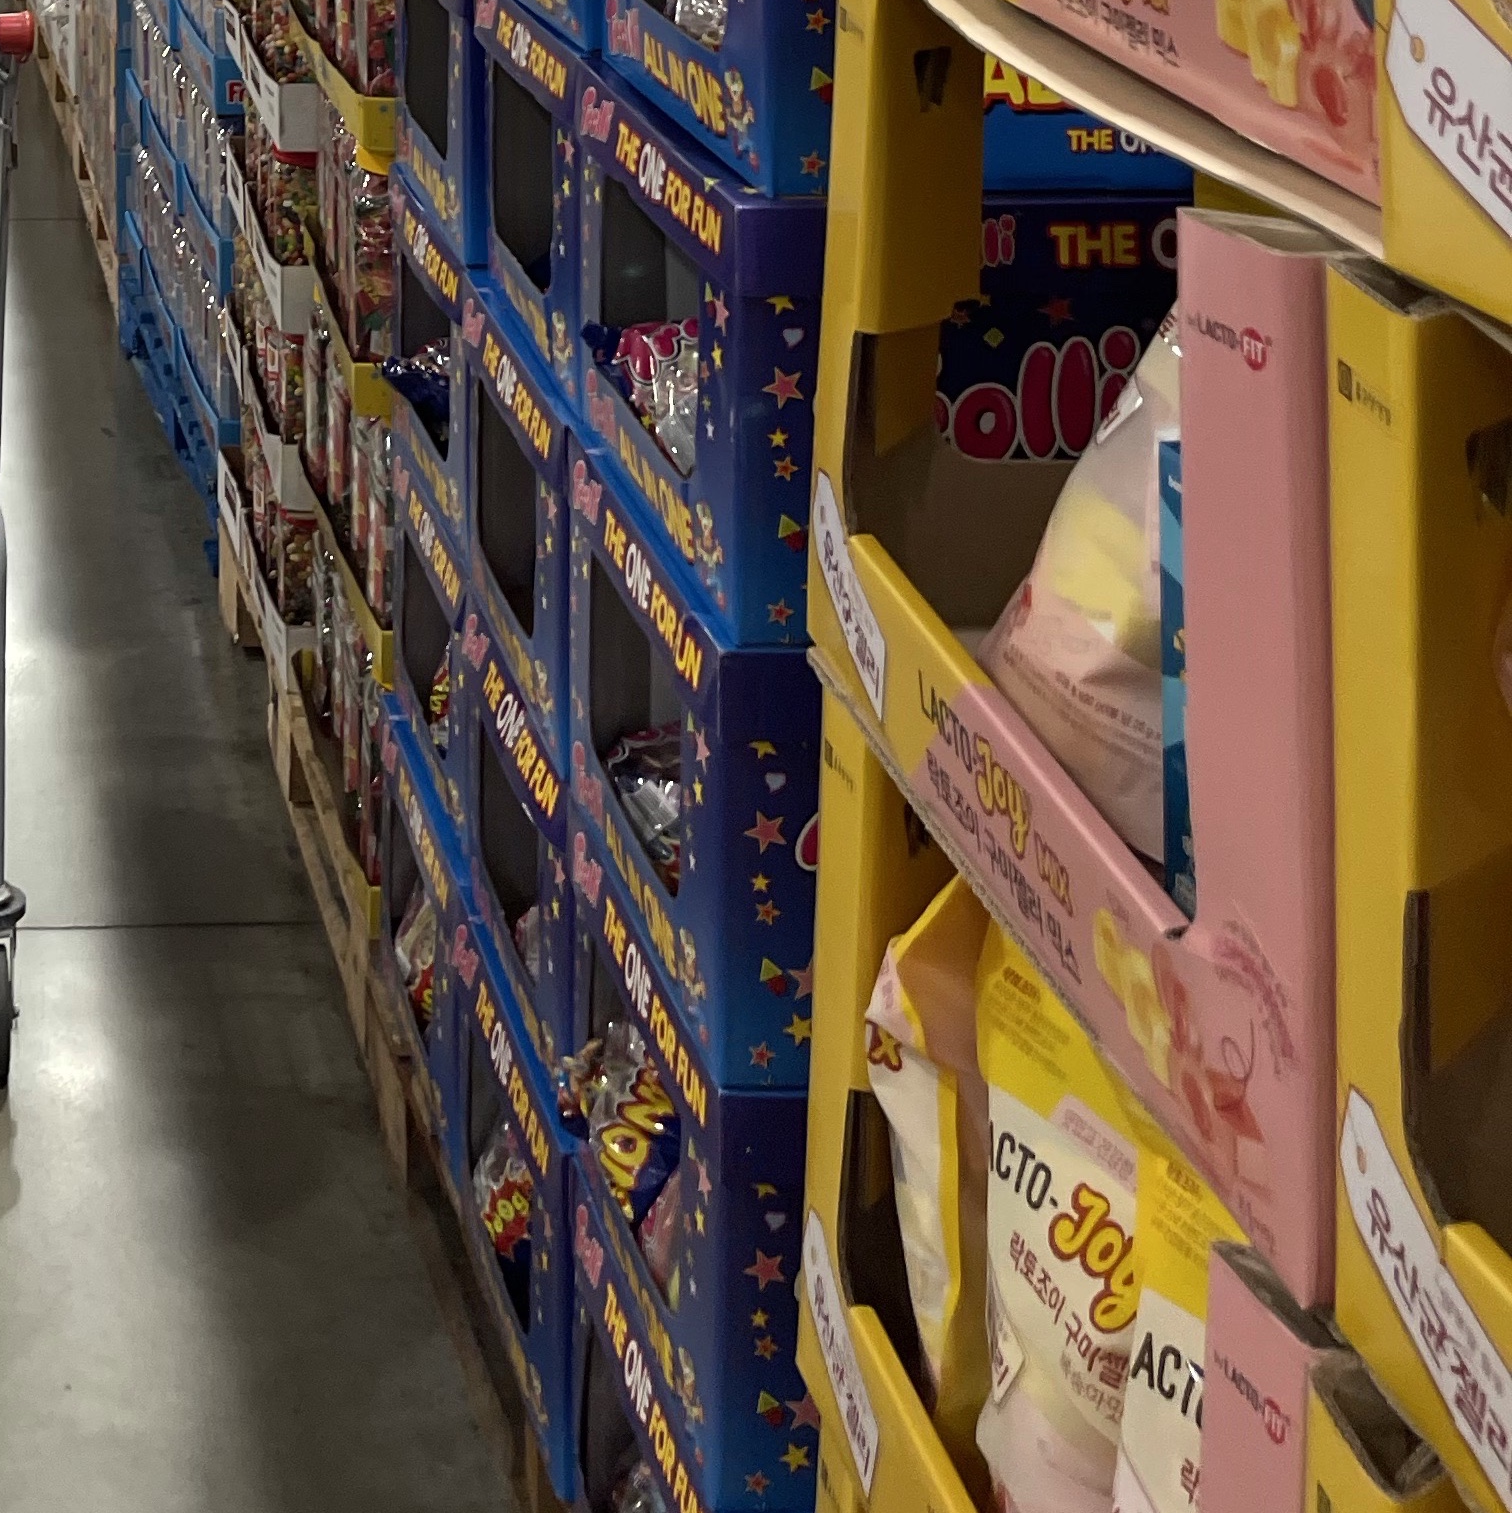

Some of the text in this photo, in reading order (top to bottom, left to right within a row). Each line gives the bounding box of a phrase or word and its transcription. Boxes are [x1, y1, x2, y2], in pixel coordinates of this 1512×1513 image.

[511, 22, 531, 68] ONE
[643, 31, 728, 136] ALL IN ONE
[615, 120, 723, 256] THE ONE FOR FUN
[1065, 128, 1115, 154] THE
[1048, 222, 1140, 270] THE
[496, 354, 518, 407] ONE
[936, 326, 1141, 464] olli
[603, 507, 627, 570] THE
[624, 542, 652, 610] ONE
[649, 582, 678, 650] FOR
[483, 658, 505, 713] THE
[496, 691, 525, 749] ONE
[513, 727, 539, 778] FOR
[529, 759, 560, 820] FUN
[603, 895, 708, 1128] THE ONE FOR FUN
[489, 1019, 513, 1085] ONE
[507, 1066, 531, 1128] FOR
[525, 1115, 550, 1177] FUN
[1009, 1230, 1131, 1390] 락토조이 구미젤
[604, 1282, 628, 1359] THE
[624, 1339, 652, 1423] ONE
[648, 1399, 677, 1486] FOR
